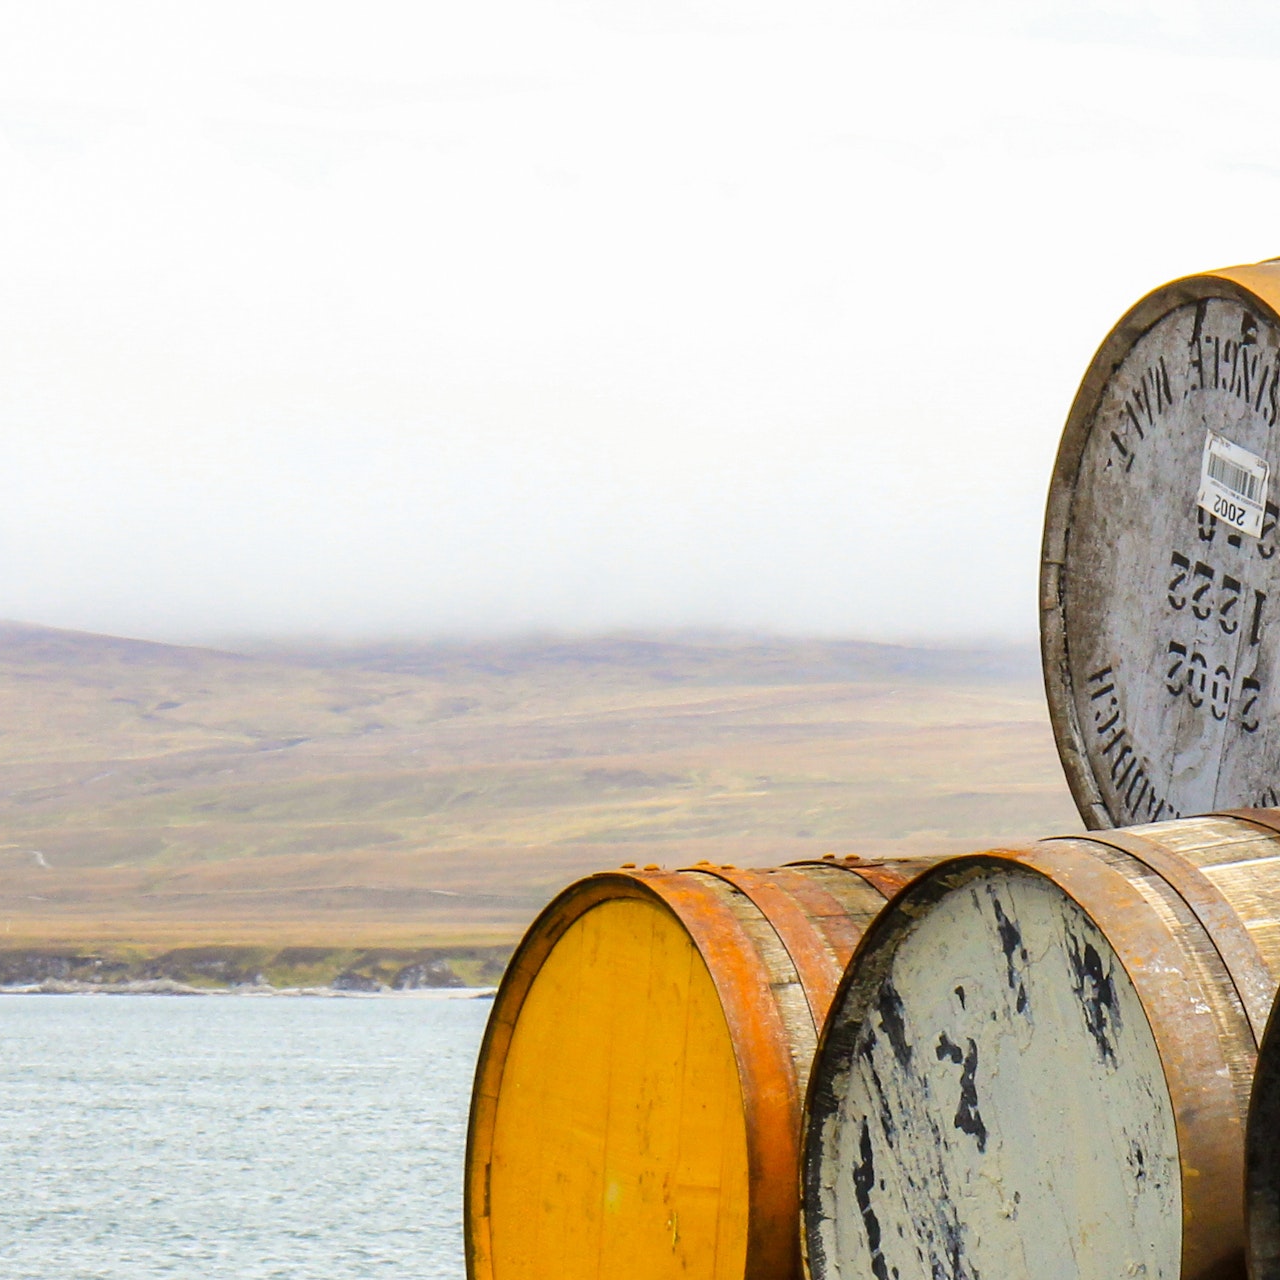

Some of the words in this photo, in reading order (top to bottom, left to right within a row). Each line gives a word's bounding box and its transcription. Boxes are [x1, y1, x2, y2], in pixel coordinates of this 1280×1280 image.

[1213, 493, 1245, 527] 2002
[1168, 550, 1267, 647] 1222
[1167, 642, 1260, 734] 2002
